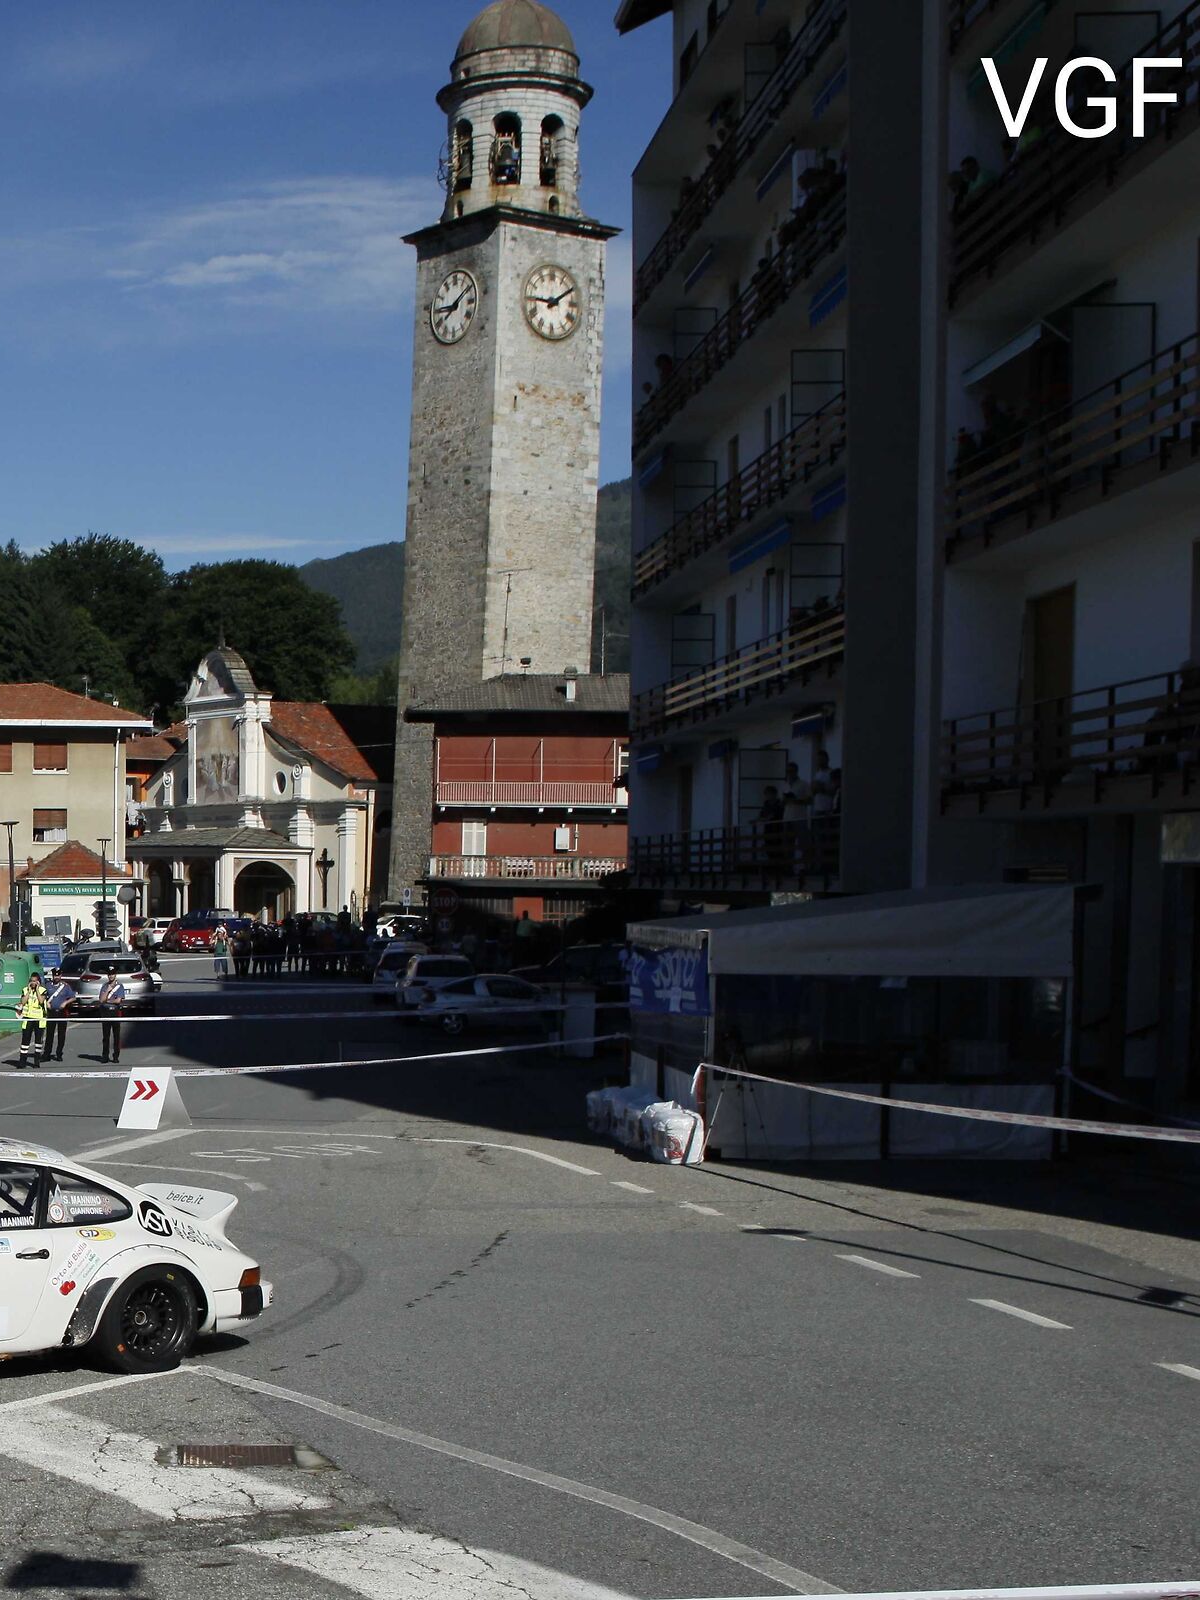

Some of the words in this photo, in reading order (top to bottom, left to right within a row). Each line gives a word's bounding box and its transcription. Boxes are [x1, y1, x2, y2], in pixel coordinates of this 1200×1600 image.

[63, 1195, 71, 1204] S.
[70, 1195, 102, 1205] MANNINO
[166, 1190, 204, 1205] beice.it
[70, 1207, 103, 1215] GIANNONE
[0, 1215, 35, 1227] MANNINO
[52, 1268, 68, 1286] Orto
[71, 1242, 88, 1261] Biella
